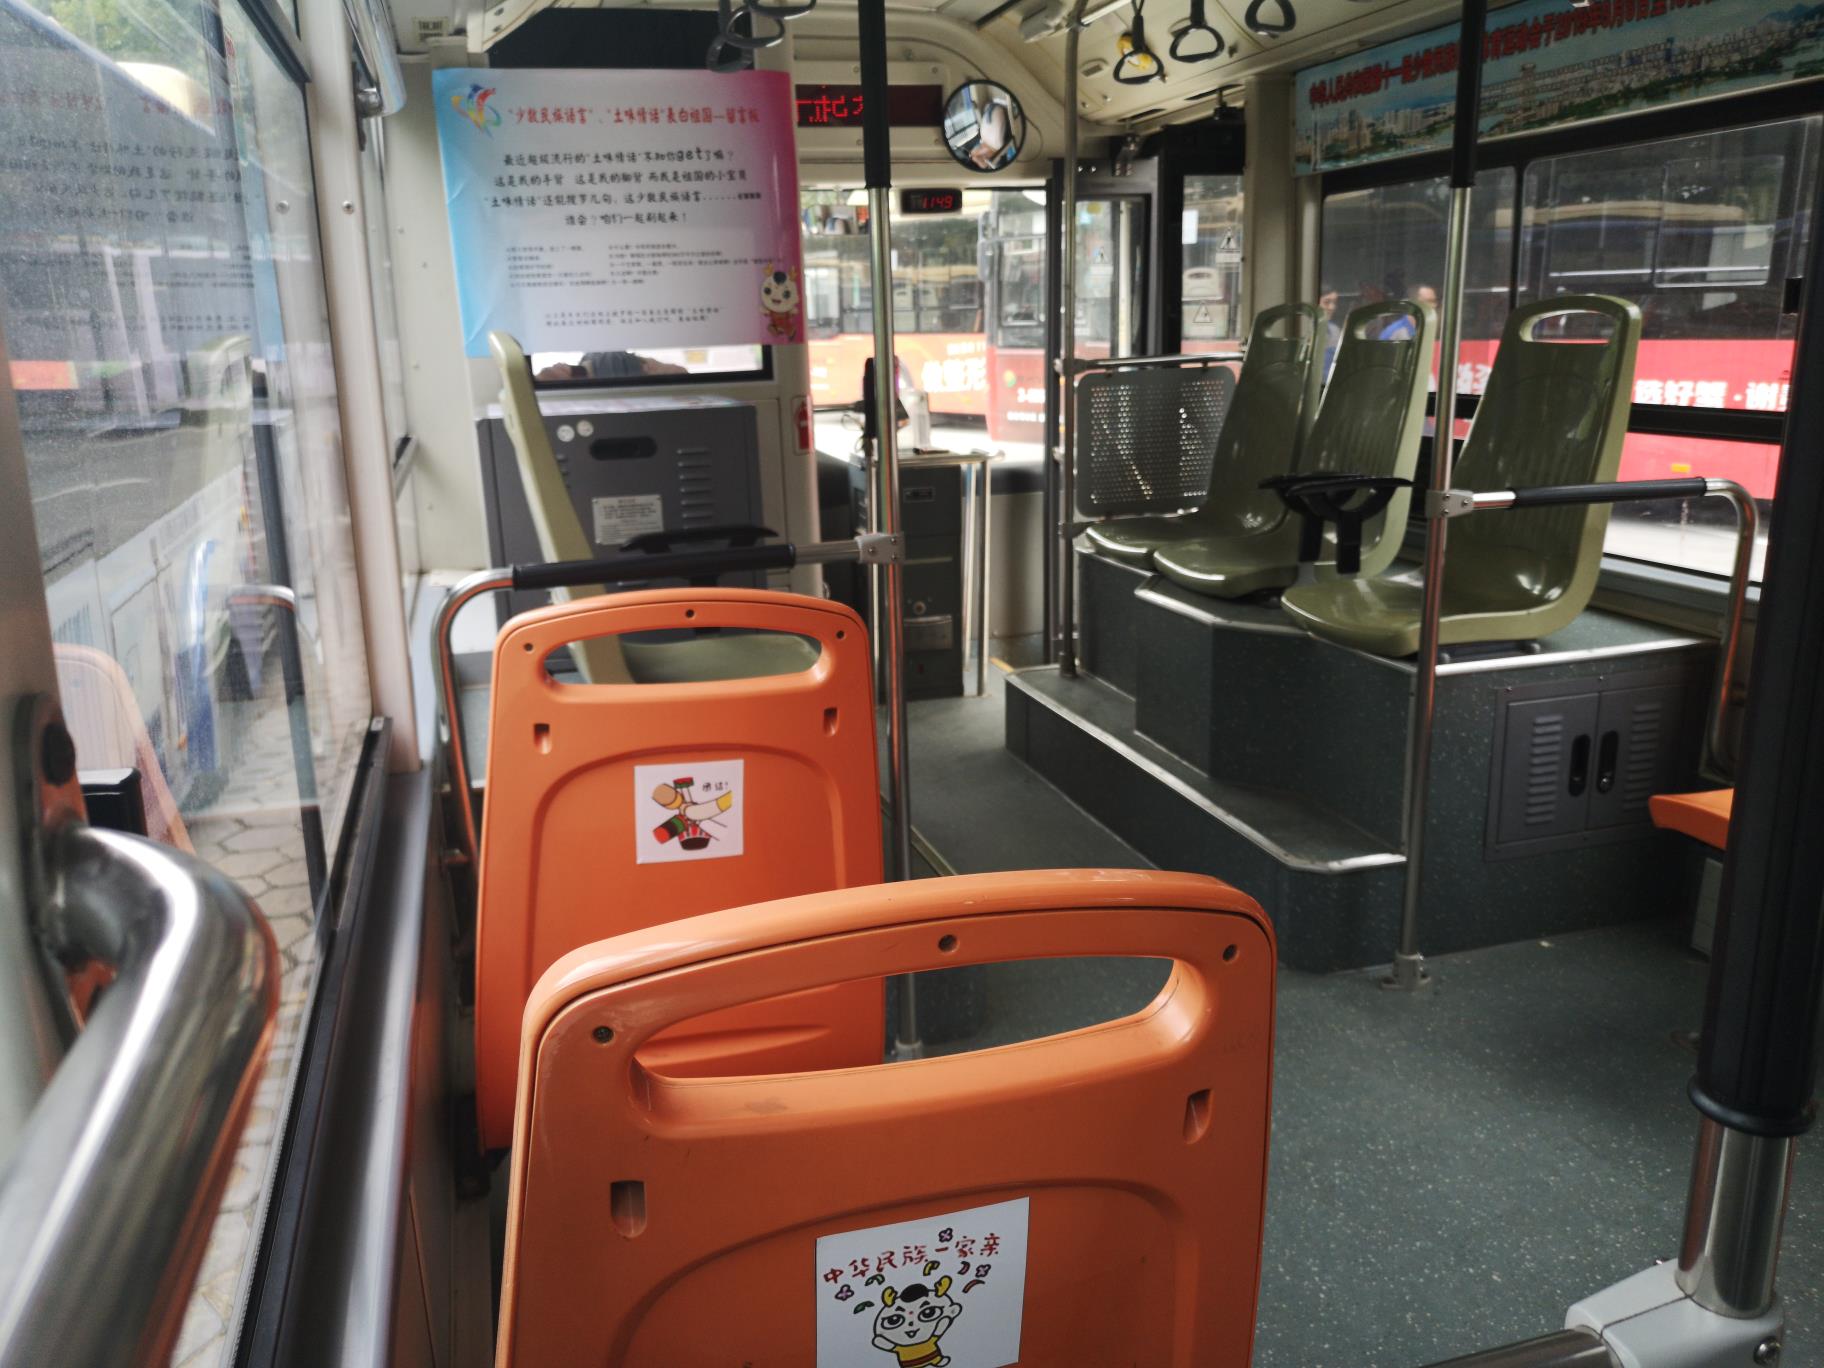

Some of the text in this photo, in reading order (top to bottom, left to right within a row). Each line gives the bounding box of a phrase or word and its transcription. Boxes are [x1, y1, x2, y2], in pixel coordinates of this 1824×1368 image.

[823, 1232, 1000, 1284] 中华民族一家亲
